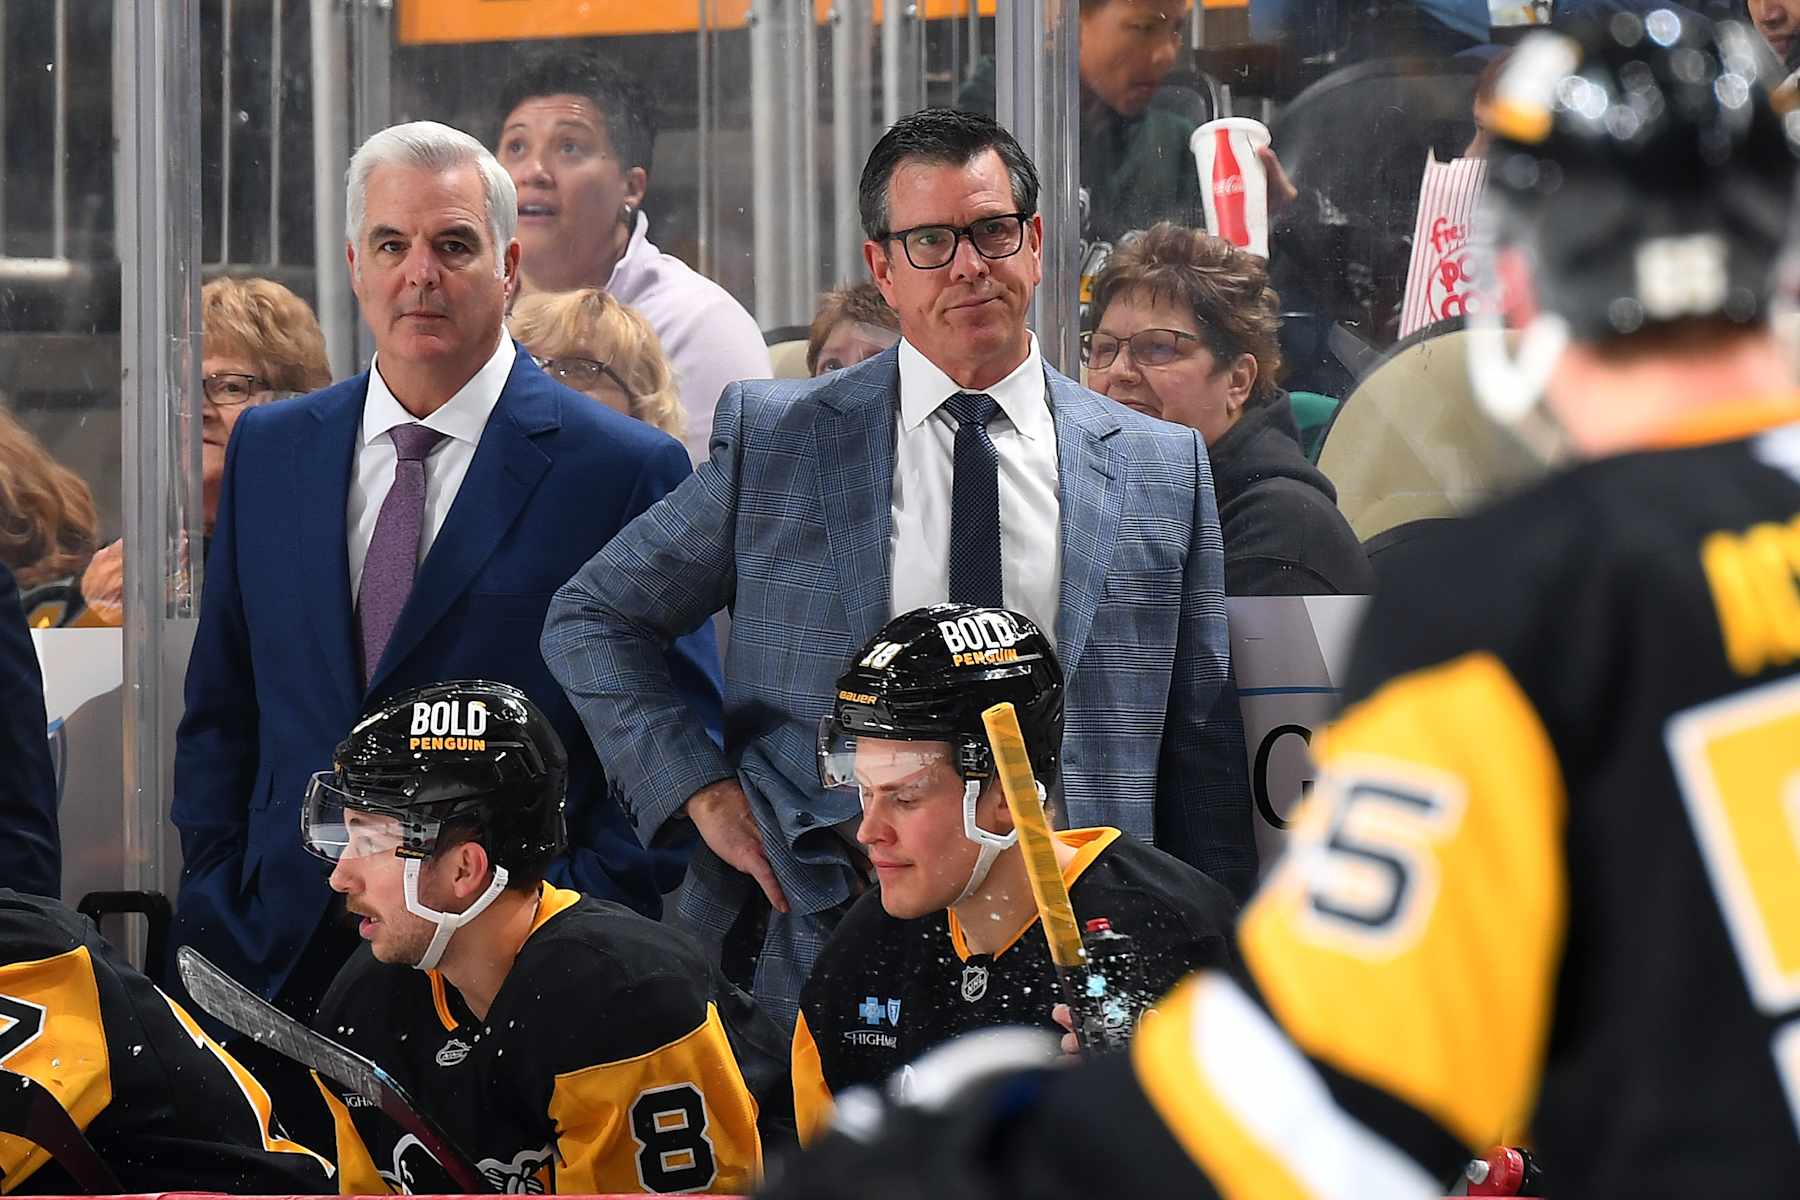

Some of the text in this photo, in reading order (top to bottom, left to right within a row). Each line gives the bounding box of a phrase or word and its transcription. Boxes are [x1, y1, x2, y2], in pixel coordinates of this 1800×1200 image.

[937, 612, 1018, 653] BOLD
[952, 648, 1018, 668] PENGUIN
[838, 690, 878, 705] BAUER
[410, 700, 487, 736] BOLD
[410, 737, 486, 751] PENGUIN
[1300, 764, 1456, 950] 5
[629, 1081, 718, 1194] 8
